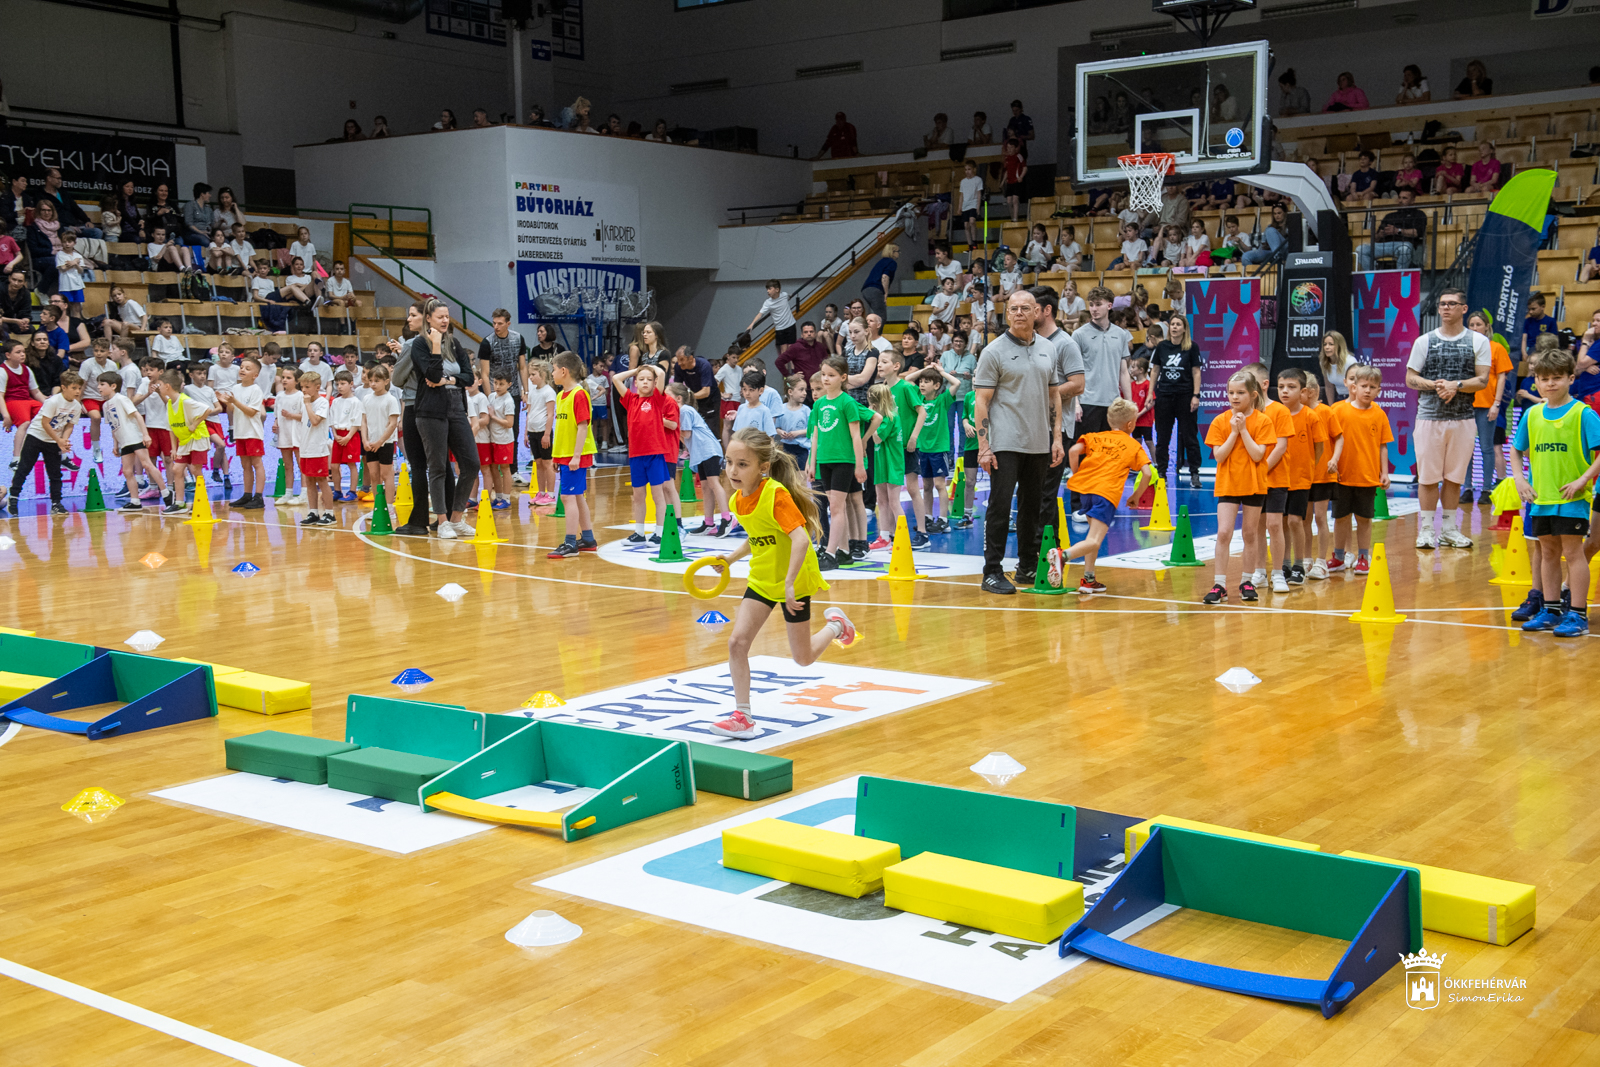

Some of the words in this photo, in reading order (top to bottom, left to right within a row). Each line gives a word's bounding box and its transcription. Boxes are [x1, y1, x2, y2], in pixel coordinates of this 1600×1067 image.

[0, 144, 85, 172] TYEKI
[91, 149, 171, 178] KÚRIA
[515, 181, 560, 193] PARTNER
[516, 192, 594, 217] BÚTORHÁZ
[517, 219, 559, 230] IRODABÚTOROK
[603, 224, 636, 242] KARRIER
[615, 242, 636, 252] BÚTOR
[517, 249, 564, 260] LAKBERENDEZÉS
[1294, 257, 1324, 265] SPALDING
[1496, 264, 1514, 323] SPORTOLÓ
[1505, 289, 1520, 333] NEMZET
[1293, 324, 1319, 337] FIBA
[1384, 390, 1407, 399] HiPer
[671, 763, 682, 791] arak
